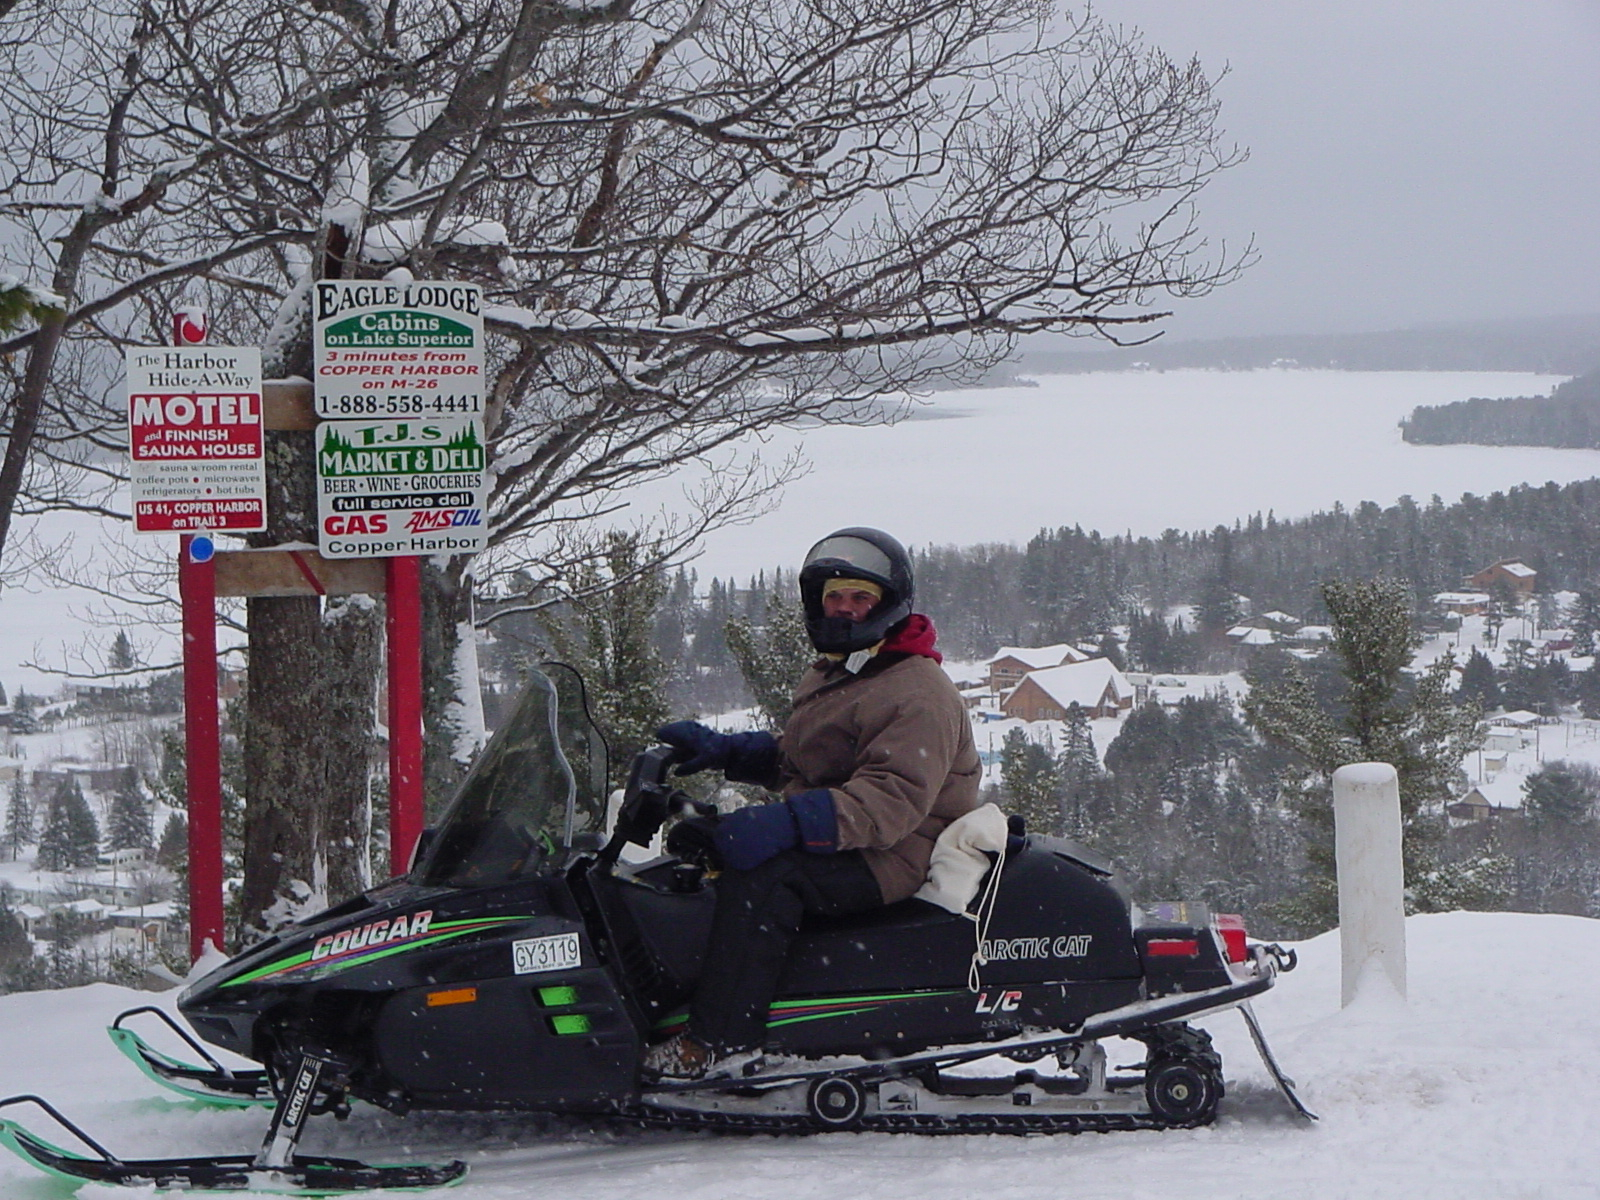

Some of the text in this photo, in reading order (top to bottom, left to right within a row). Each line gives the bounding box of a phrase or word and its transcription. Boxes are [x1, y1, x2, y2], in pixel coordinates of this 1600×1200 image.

[317, 283, 480, 322] EAGLE LODGE
[360, 313, 440, 331] Cabins
[327, 332, 472, 347] on Lake Superior
[135, 353, 237, 369] The Harbor
[326, 351, 466, 362] 3 minutes from
[319, 365, 479, 376] COPPER HARBOR
[149, 372, 253, 390] Hide-A-Way
[362, 379, 438, 389] on M-26
[133, 396, 259, 426] MOTEL
[320, 394, 480, 414] 1-888-558-4441
[144, 429, 229, 443] and FINNISH
[139, 443, 256, 457] SAUNA HOUSE
[201, 464, 227, 472] room
[230, 462, 258, 471] rental
[322, 448, 480, 475] MARKET & DELI
[136, 474, 261, 486] coffee pots microwaves
[324, 474, 482, 494] BEER WINE GROCERIES
[142, 485, 255, 497] refrigerators hot tubs
[139, 501, 260, 517] US 41, COPPER HARBOR
[337, 498, 365, 510] full
[370, 496, 434, 509] service
[172, 516, 227, 528] on TRAIL 3
[324, 509, 482, 536] GAS AMSOIL
[328, 537, 479, 555] Copper Harbor
[311, 910, 433, 961] COUGAR
[515, 938, 578, 968] GY3119
[980, 935, 1092, 960] ARCTIC CAT
[975, 989, 1022, 1014] L/C
[286, 1070, 312, 1125] ARCTIC CAT
